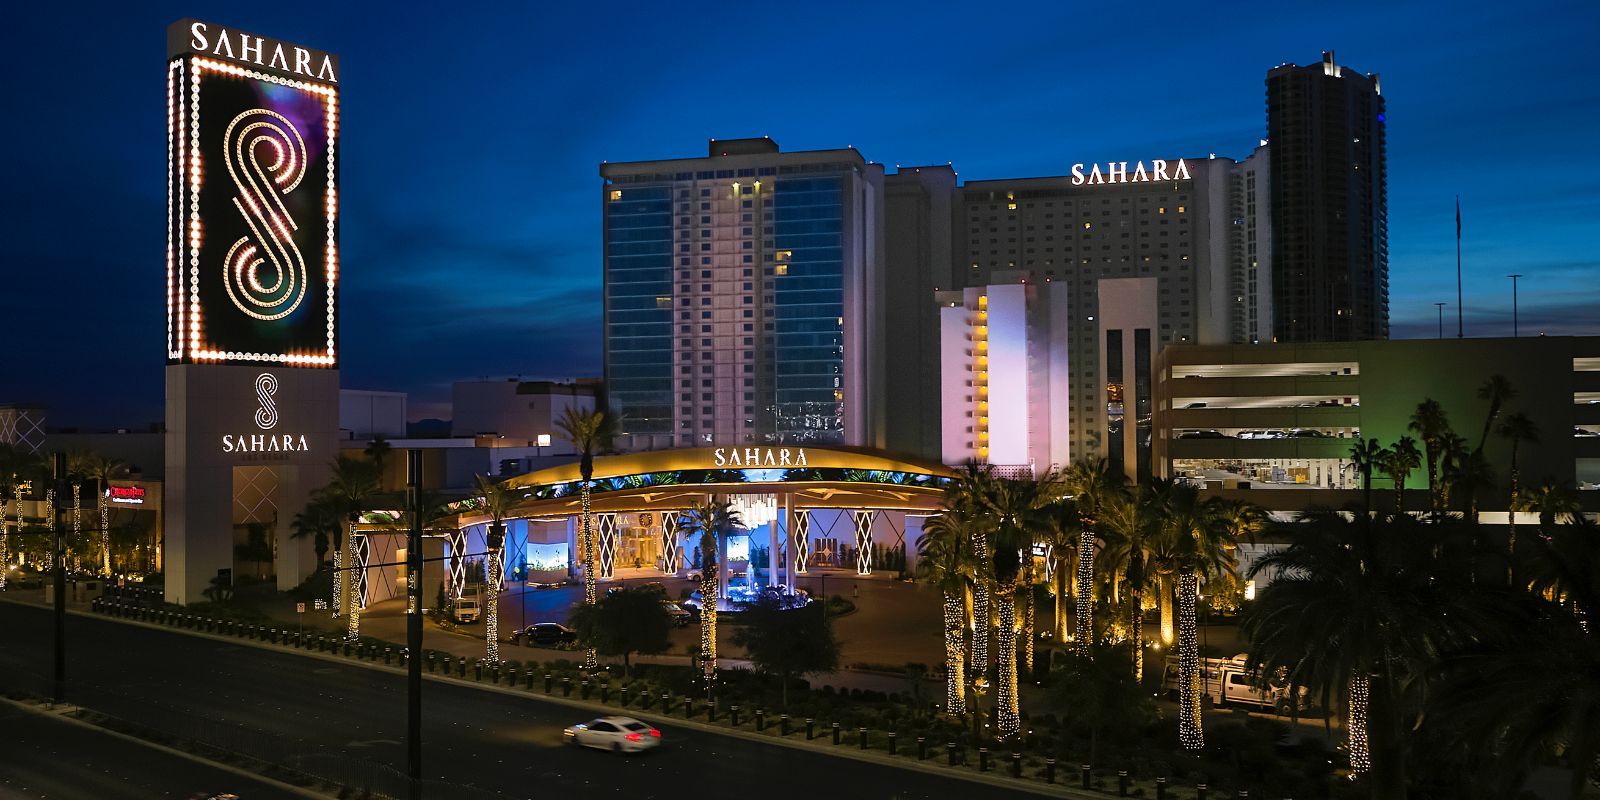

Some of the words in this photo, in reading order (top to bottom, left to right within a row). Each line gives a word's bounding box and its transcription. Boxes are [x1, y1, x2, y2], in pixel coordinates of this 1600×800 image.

[191, 22, 337, 83] SAHARA
[1071, 158, 1192, 186] SAHARA
[222, 435, 309, 452] SAHARA
[714, 448, 808, 467] SAHARA
